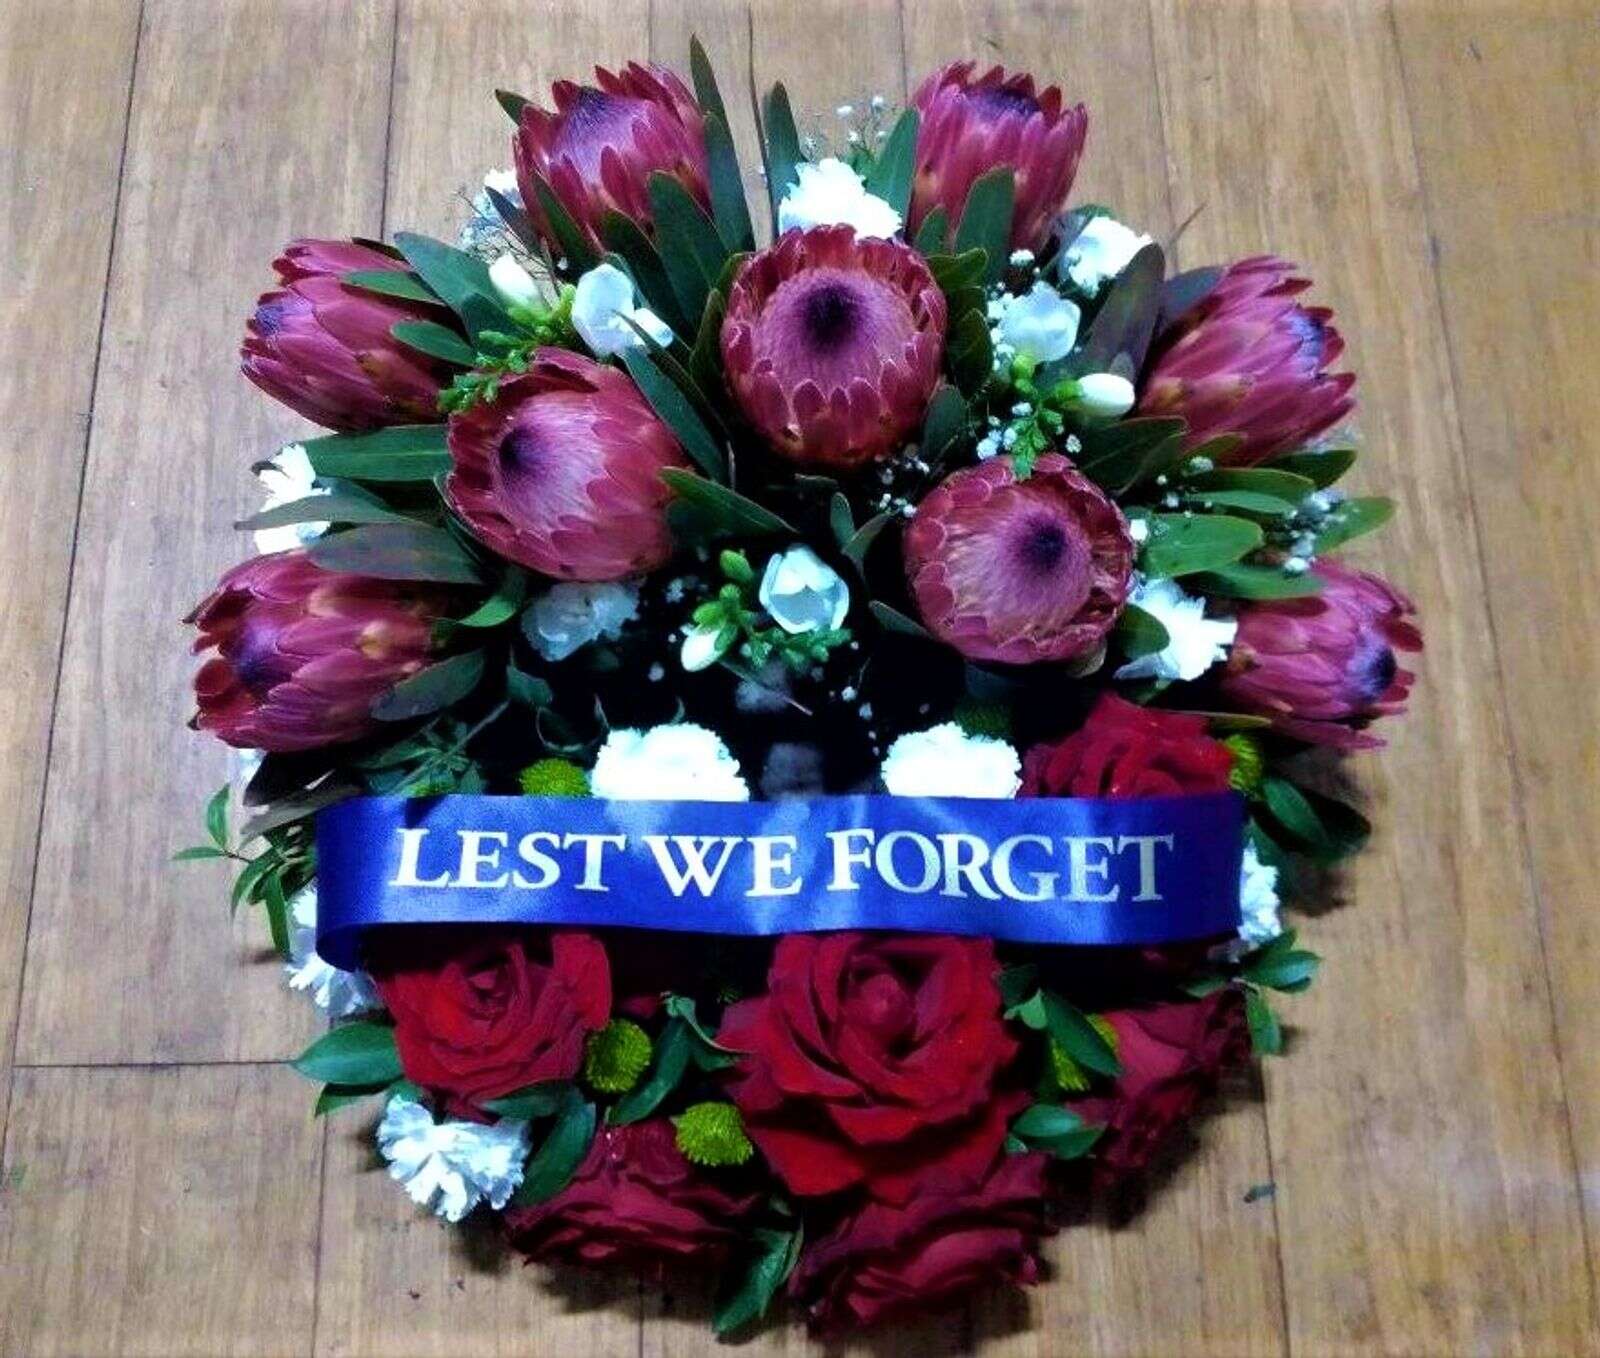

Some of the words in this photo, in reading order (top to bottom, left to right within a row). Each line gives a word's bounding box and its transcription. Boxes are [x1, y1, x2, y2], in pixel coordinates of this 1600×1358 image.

[388, 828, 626, 892] LEST
[641, 834, 803, 898] WE
[826, 828, 1175, 904] FORGET
